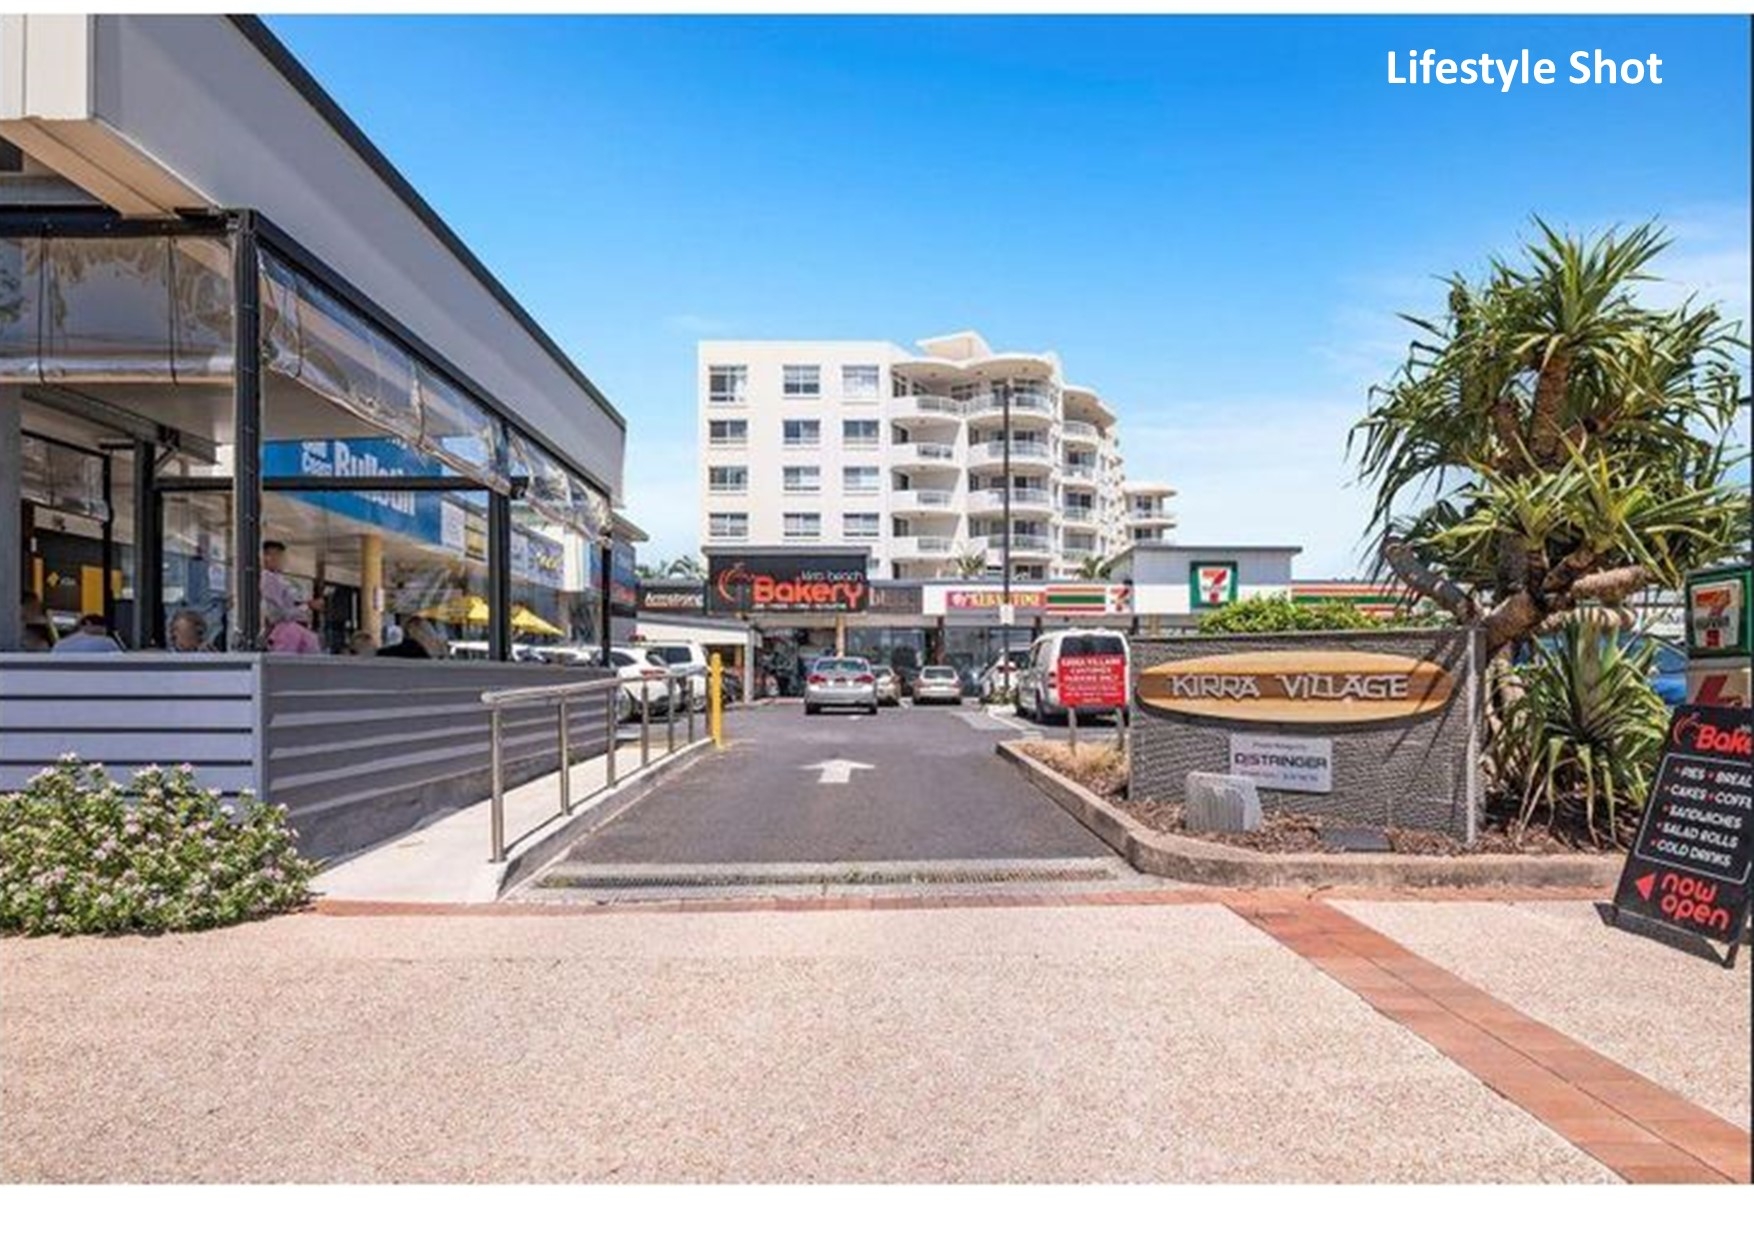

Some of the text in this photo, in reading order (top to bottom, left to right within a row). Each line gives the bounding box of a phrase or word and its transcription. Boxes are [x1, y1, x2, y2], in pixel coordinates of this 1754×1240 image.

[753, 575, 864, 609] Bakery
[1170, 673, 1410, 700] KIRRA VILLAGE
[1670, 784, 1707, 801] CAKES
[1669, 805, 1743, 829] SANDWICHES
[1663, 822, 1739, 849] SALAD ROLLS
[1657, 839, 1732, 868] COLD DRINKS
[1660, 873, 1718, 902] now
[1660, 893, 1729, 930] open
